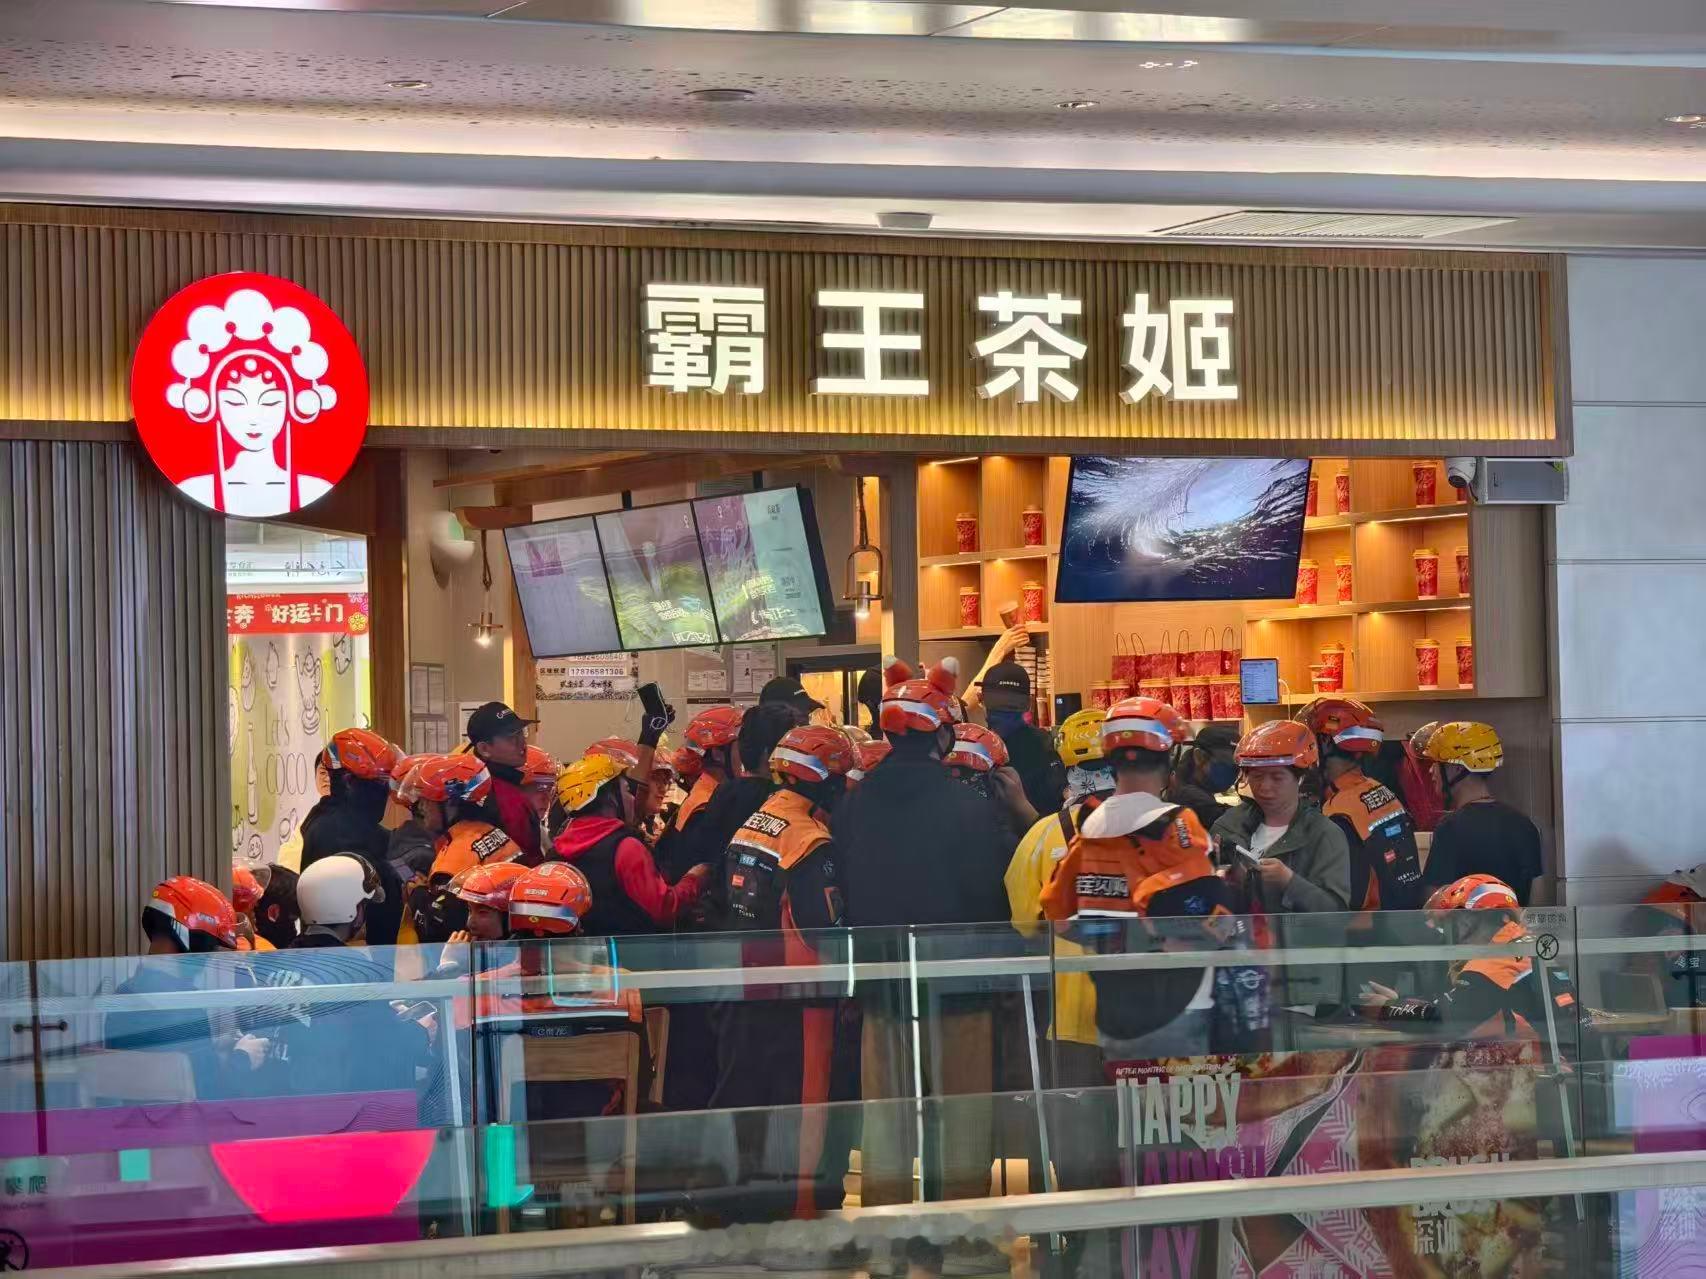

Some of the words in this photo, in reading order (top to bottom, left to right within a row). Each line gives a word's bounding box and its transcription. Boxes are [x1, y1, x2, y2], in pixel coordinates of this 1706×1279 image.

[645, 283, 1239, 405] 霸王茶姬
[271, 602, 344, 624] 好运上门
